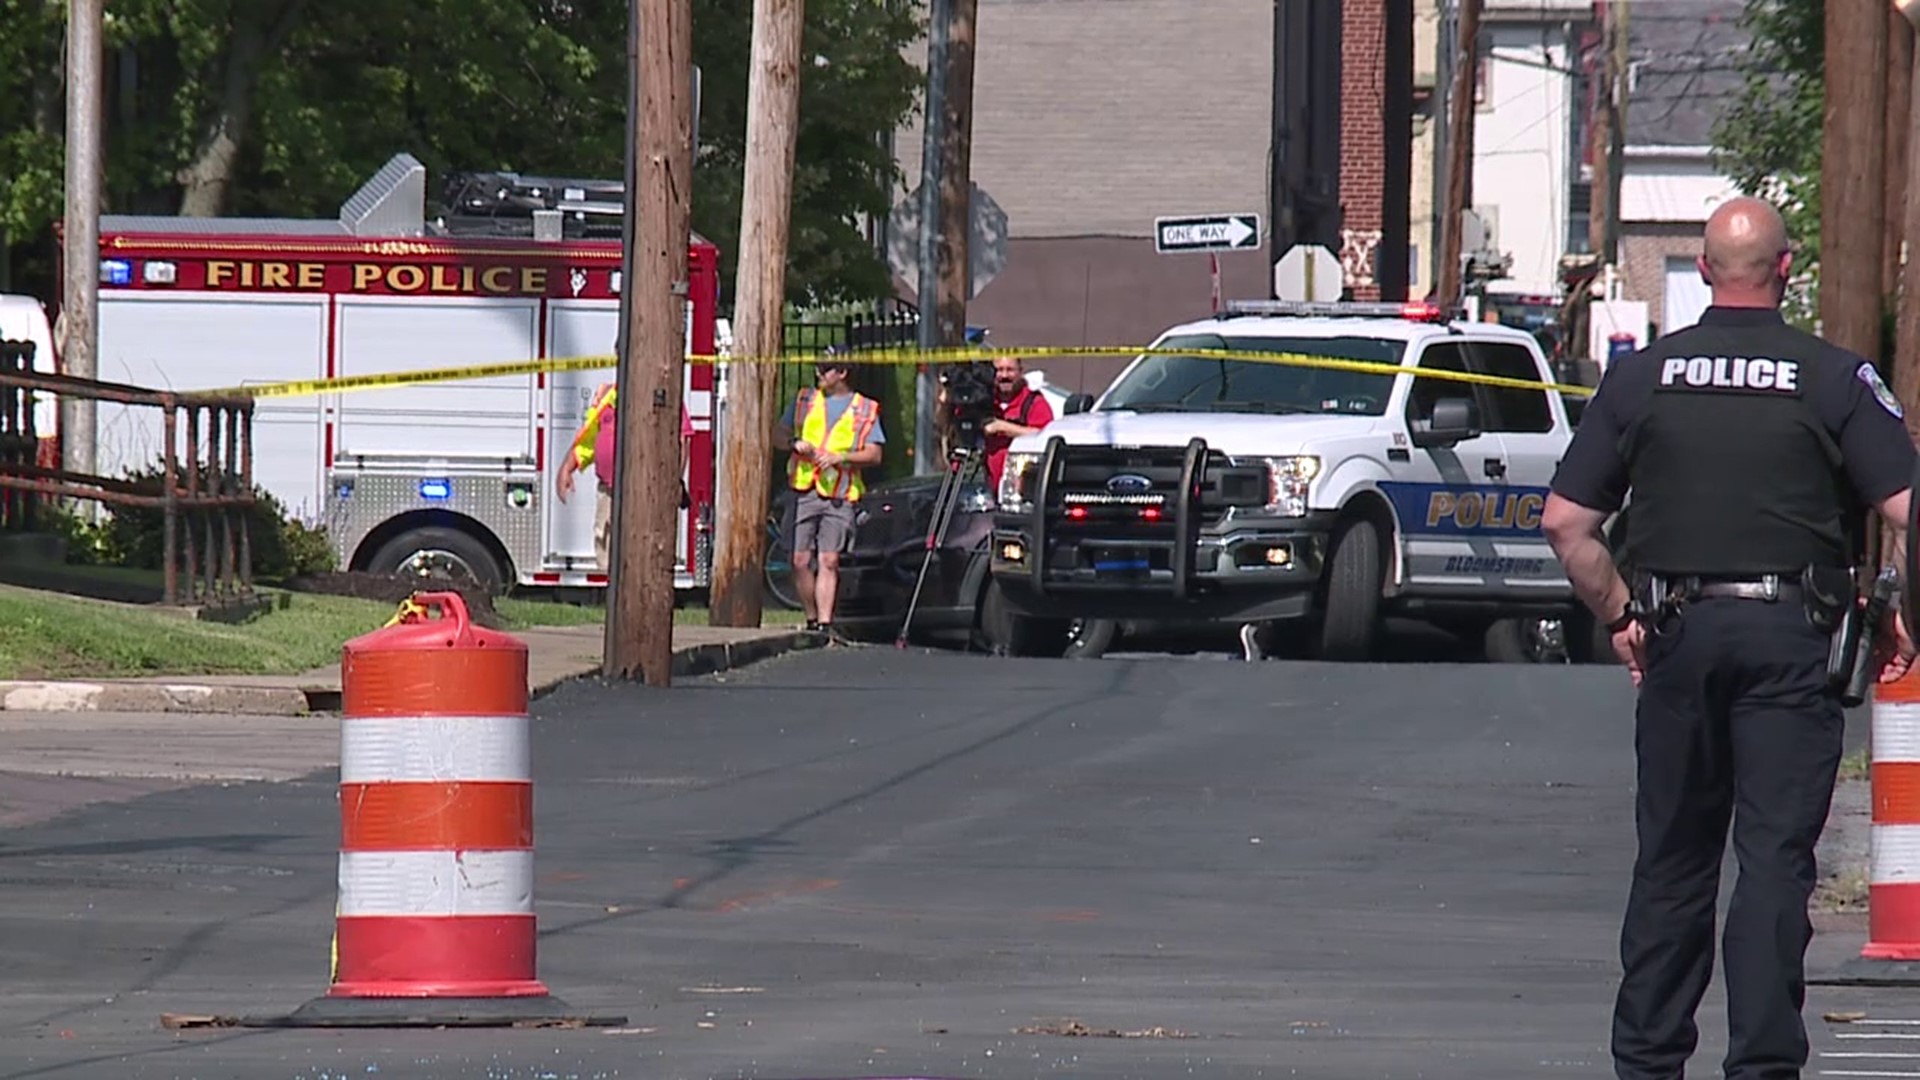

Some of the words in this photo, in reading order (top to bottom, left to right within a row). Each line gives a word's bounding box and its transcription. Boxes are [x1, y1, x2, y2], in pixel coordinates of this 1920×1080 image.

[1166, 228, 1193, 241] ONE
[1199, 226, 1228, 238] WAY
[206, 260, 326, 288] FIRE
[353, 263, 548, 294] POLICE
[1660, 357, 1799, 391] POLICE
[1425, 491, 1544, 530] POLIC
[1444, 555, 1546, 574] BLOOMSBURG
